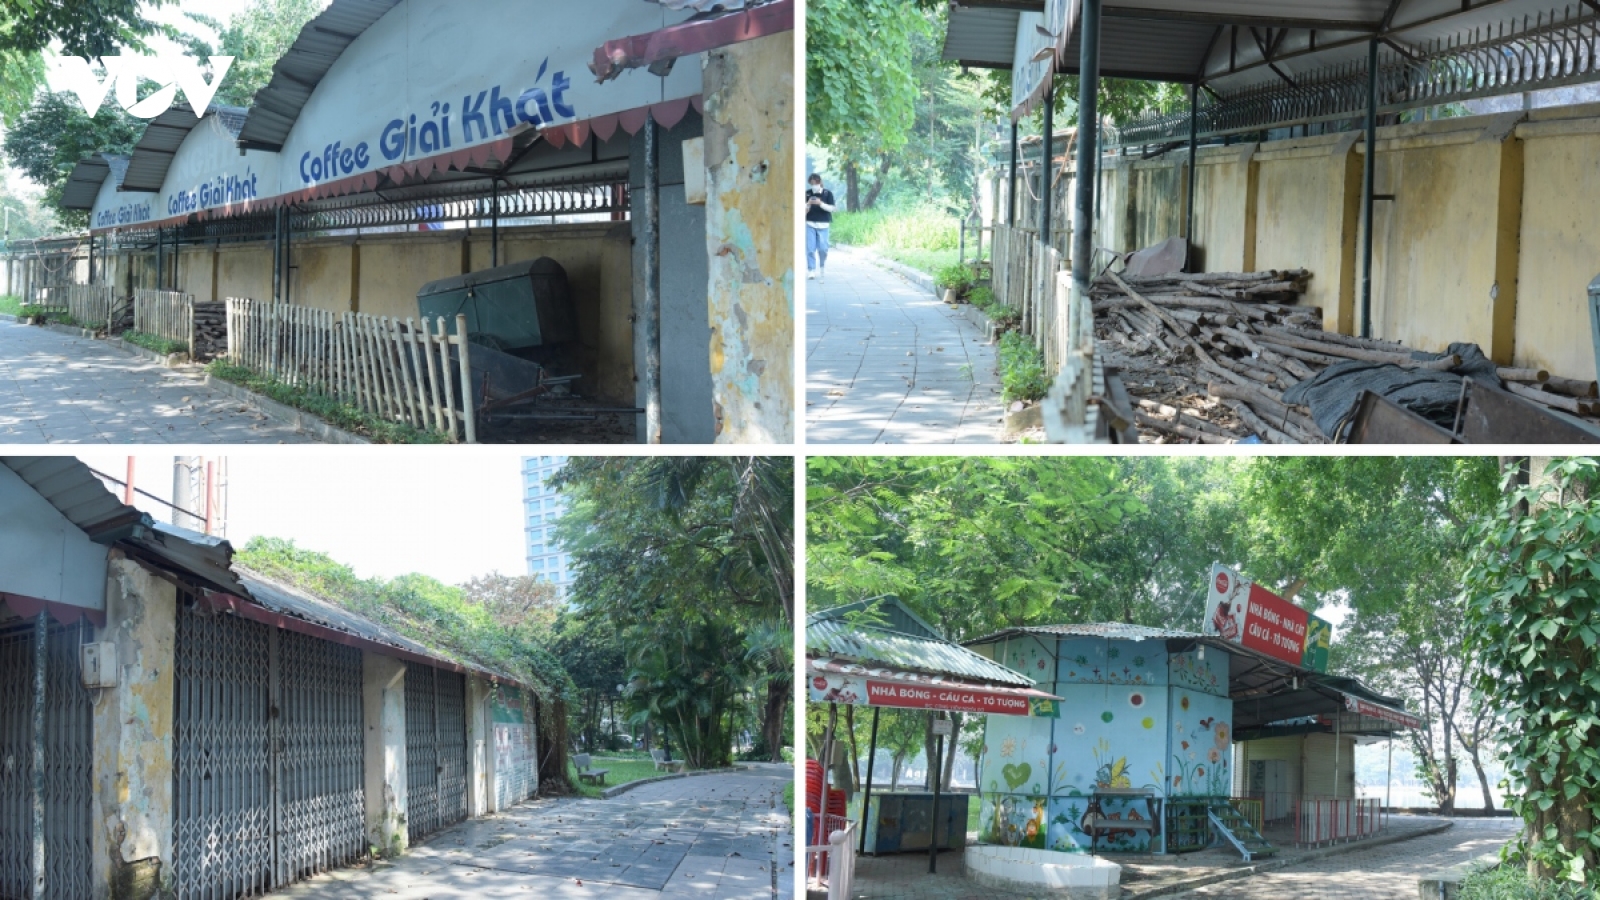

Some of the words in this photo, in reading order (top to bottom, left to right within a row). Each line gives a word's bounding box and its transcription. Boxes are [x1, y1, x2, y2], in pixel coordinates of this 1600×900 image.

[300, 140, 370, 184] Coffee
[380, 101, 451, 160] Giải
[461, 56, 576, 143] Khát
[168, 190, 197, 215] Coffee
[200, 175, 225, 208] Giải
[226, 165, 257, 203] Khát
[871, 685, 897, 697] NHÀ
[899, 688, 931, 700] BÓNG
